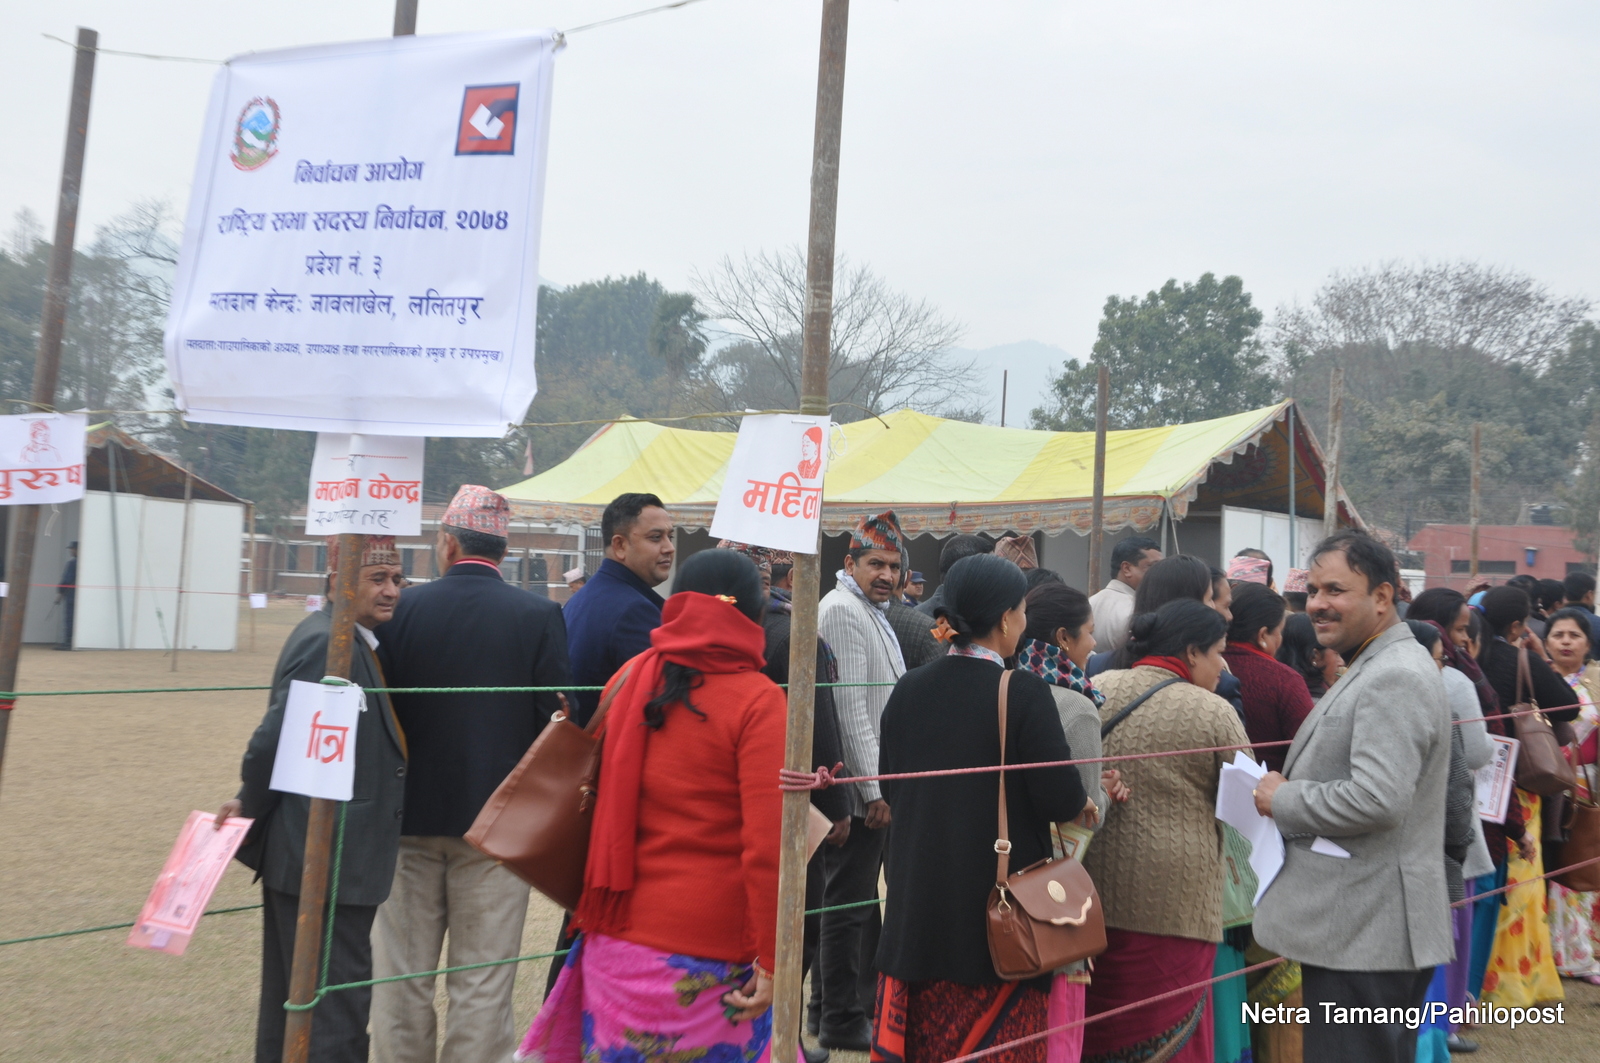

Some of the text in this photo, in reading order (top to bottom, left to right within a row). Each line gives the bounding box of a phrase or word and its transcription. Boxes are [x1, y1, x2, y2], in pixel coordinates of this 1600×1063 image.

[294, 155, 425, 184] निर्वाचन आयोग
[271, 211, 309, 232] सभा
[313, 210, 370, 232] सदस्य
[456, 209, 509, 230] २०७४
[305, 249, 343, 276] प्रदेश
[373, 255, 383, 280] ३
[310, 288, 397, 321] जावलाखेल,
[408, 288, 485, 325] ललितपुर
[368, 472, 422, 504] केन्द्र
